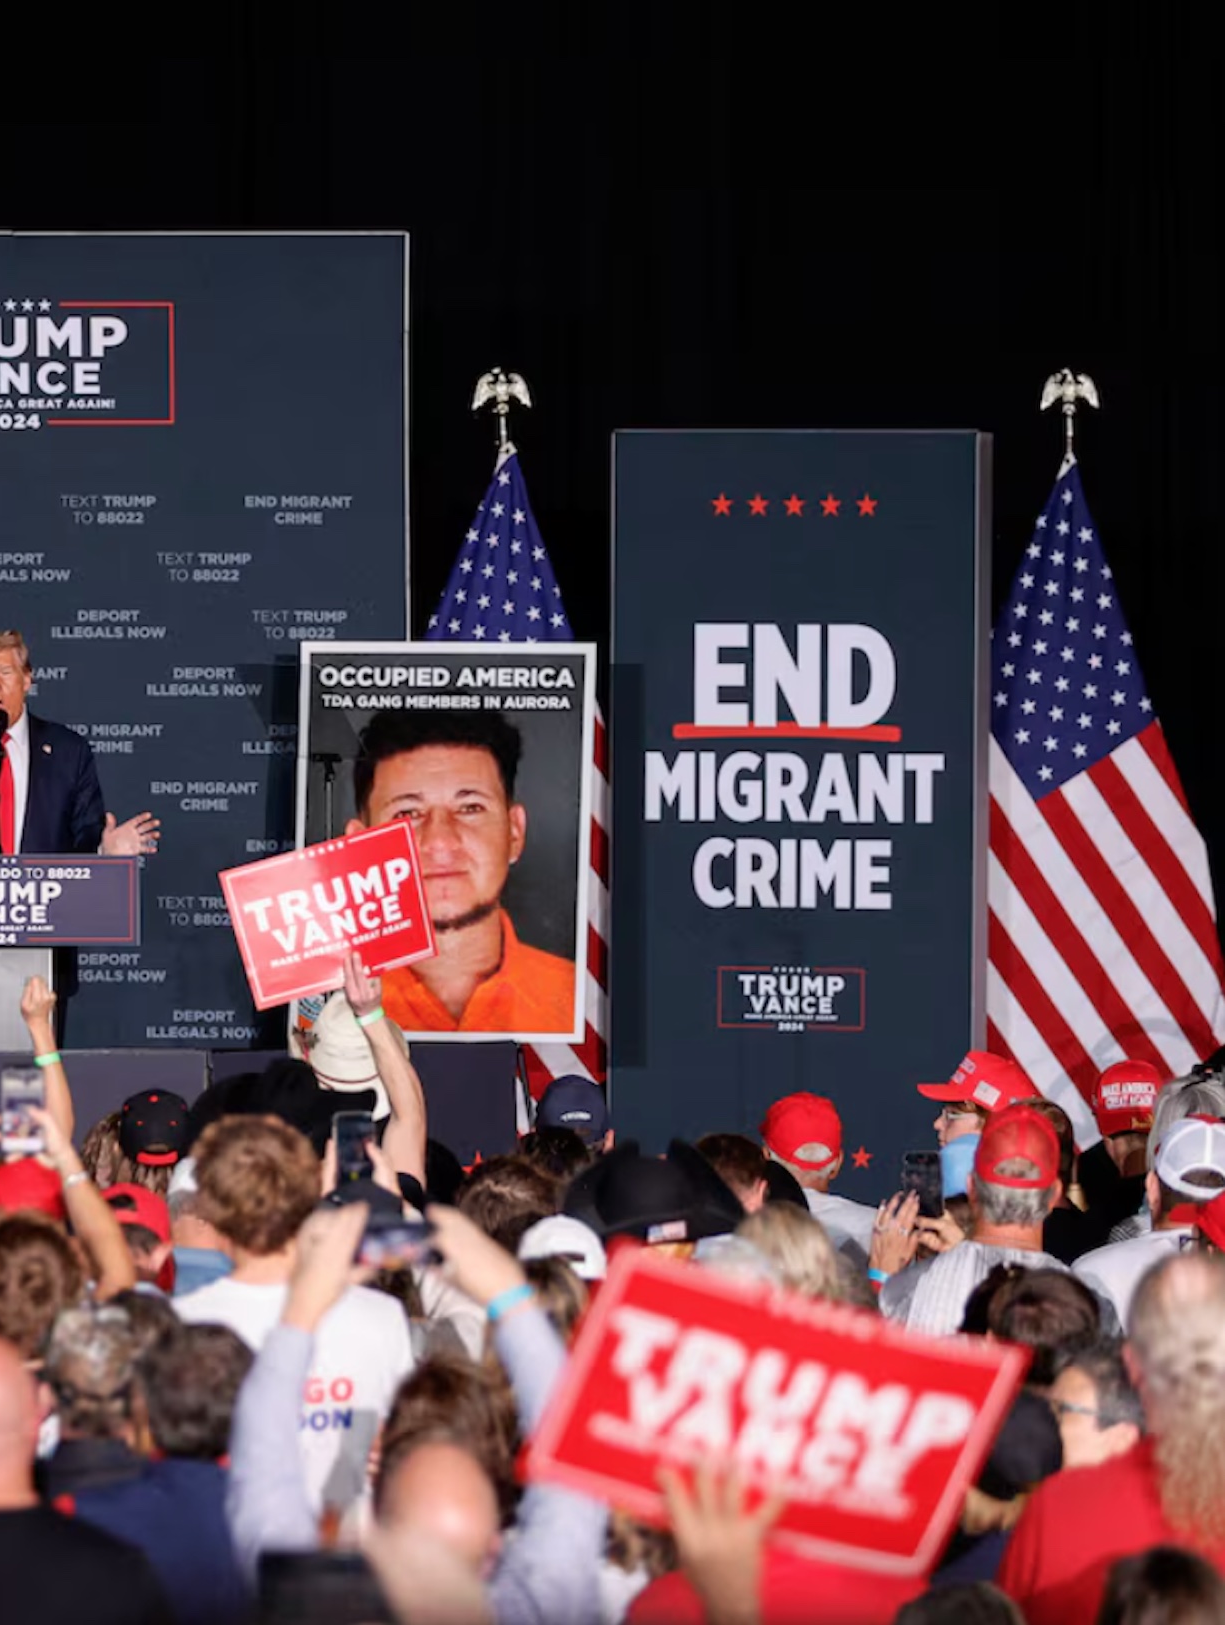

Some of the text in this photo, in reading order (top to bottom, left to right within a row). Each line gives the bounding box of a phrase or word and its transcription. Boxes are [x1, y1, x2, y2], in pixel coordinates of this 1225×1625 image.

[18, 399, 62, 409] GREAT
[67, 399, 115, 409] AGAIN!
[61, 495, 156, 508] TEXT TRUMP
[245, 496, 352, 508] END MIGRANT
[73, 511, 143, 525] TO 88022
[274, 512, 322, 524] CRIME
[157, 552, 251, 565] TEXT TRUMP
[32, 569, 70, 582] NOW
[169, 569, 239, 582] TO 88022
[78, 610, 139, 622] DEPORT
[252, 610, 347, 623] TEXT TRUMP
[52, 626, 166, 638] ILLEGALS NOW
[264, 627, 335, 639] TO 88022
[173, 667, 235, 679] DEPORT
[320, 667, 574, 688] OCCUPIED AMERICA
[694, 622, 897, 729] END
[147, 684, 261, 696] ILLEGALS NOW
[322, 694, 570, 708] TDA GANG MEMBERS IN AURORA
[92, 724, 163, 736] MIGRANT
[151, 782, 258, 794] END MIGRANT
[645, 752, 944, 823] MIGRANT
[180, 798, 228, 811] CRIME
[246, 840, 278, 852] END
[24, 868, 44, 879] TO
[48, 868, 90, 879] 88022
[694, 838, 891, 909] CRIME
[243, 858, 411, 932] TRUMP
[157, 896, 195, 909] TEXT
[169, 912, 230, 926] TO 8802
[272, 895, 402, 953] VANCE
[78, 954, 140, 965] DEPORT
[128, 970, 166, 982] NOW
[738, 974, 845, 996] TRUMP
[750, 996, 832, 1014] VANCE
[173, 1010, 235, 1022] DEPORT
[146, 1026, 260, 1038] ILLEGALS NOW
[611, 1306, 979, 1450] TRUMP
